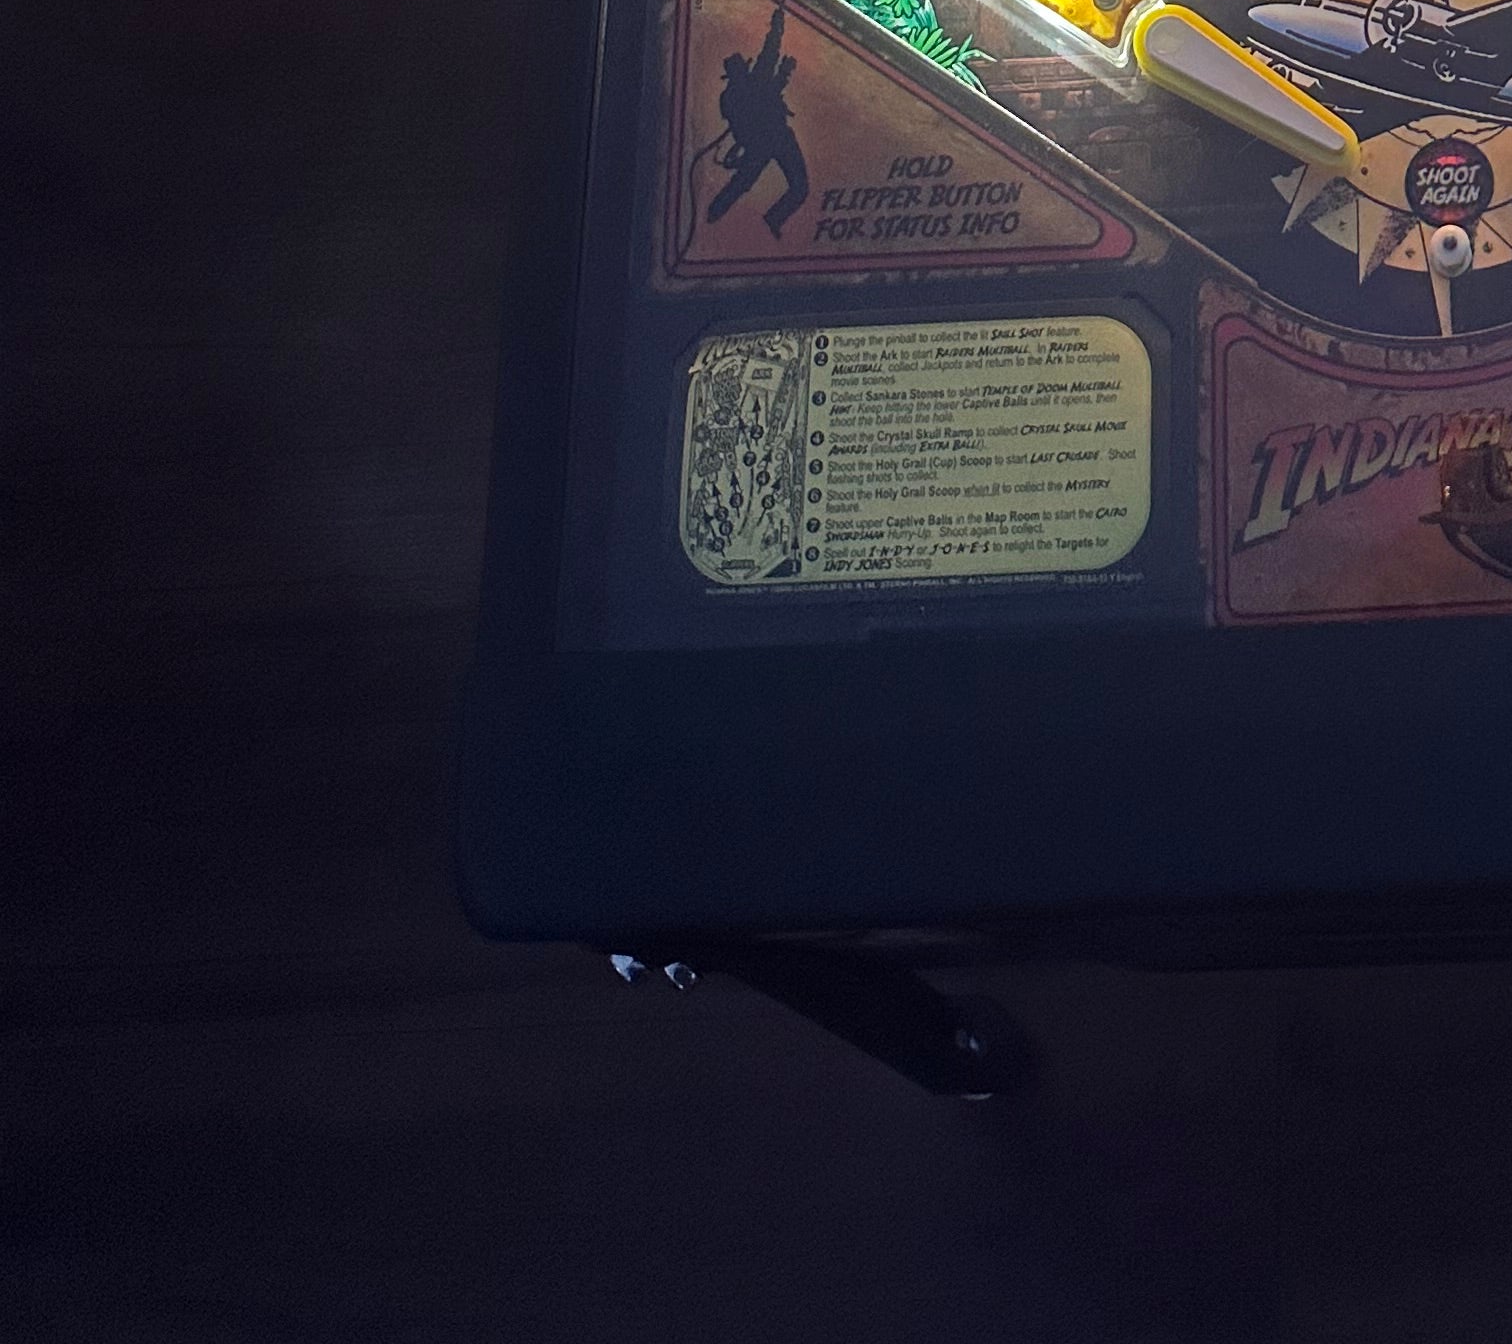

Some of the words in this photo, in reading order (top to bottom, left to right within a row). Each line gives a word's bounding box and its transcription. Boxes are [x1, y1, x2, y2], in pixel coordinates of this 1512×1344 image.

[888, 153, 954, 180] HOLD
[1416, 162, 1480, 189] SHOOT
[820, 184, 926, 213] FLIPPER
[930, 180, 1025, 209] BUTTON
[1419, 183, 1480, 206] AGAIN
[812, 216, 867, 243] FOR
[869, 213, 954, 240] STATUS
[957, 209, 1022, 237] INFO
[866, 389, 907, 401] Sankara
[909, 387, 945, 400] Stones
[962, 398, 1001, 410] Captive
[1002, 396, 1028, 409] Balls
[877, 430, 914, 445] Crystal
[916, 427, 942, 440] Skull
[944, 426, 974, 440] Ramp
[875, 458, 899, 475] Holy
[902, 456, 927, 469] Grail
[960, 455, 993, 469] Scoop
[1030, 452, 1055, 464] LAST
[1233, 412, 1505, 556] INDIANA
[1010, 510, 1041, 523] Room
